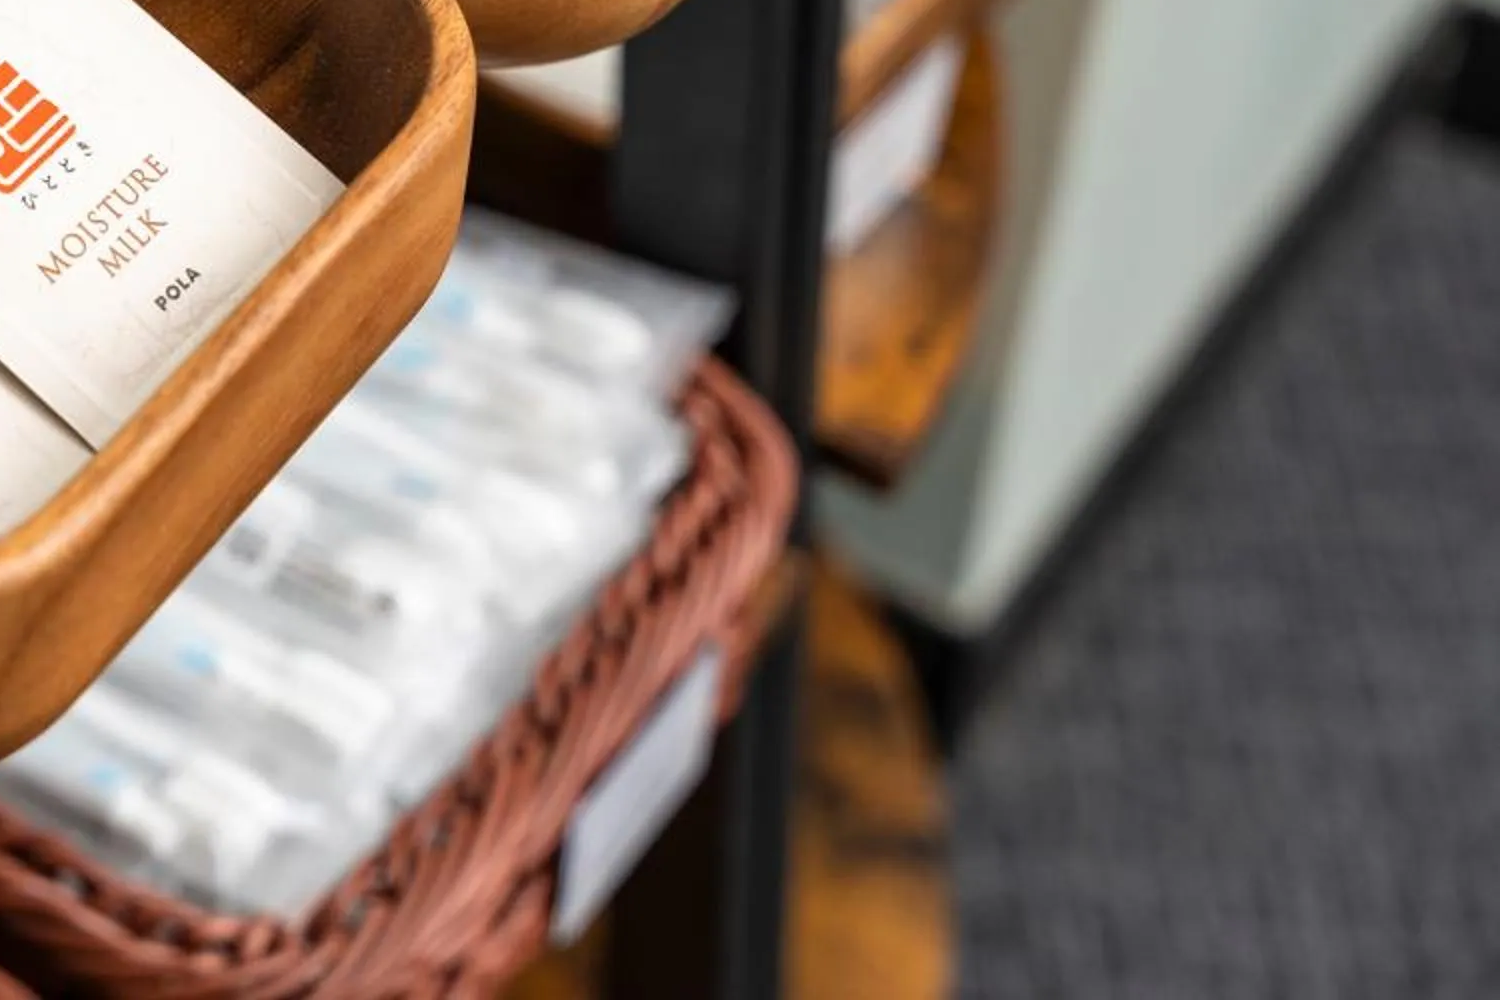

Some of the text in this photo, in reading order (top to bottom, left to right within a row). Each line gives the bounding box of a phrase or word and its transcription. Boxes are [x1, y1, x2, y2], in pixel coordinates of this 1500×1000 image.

[36, 154, 169, 284] MOISTURE
[97, 208, 169, 278] MILK
[154, 268, 201, 311] POLA
